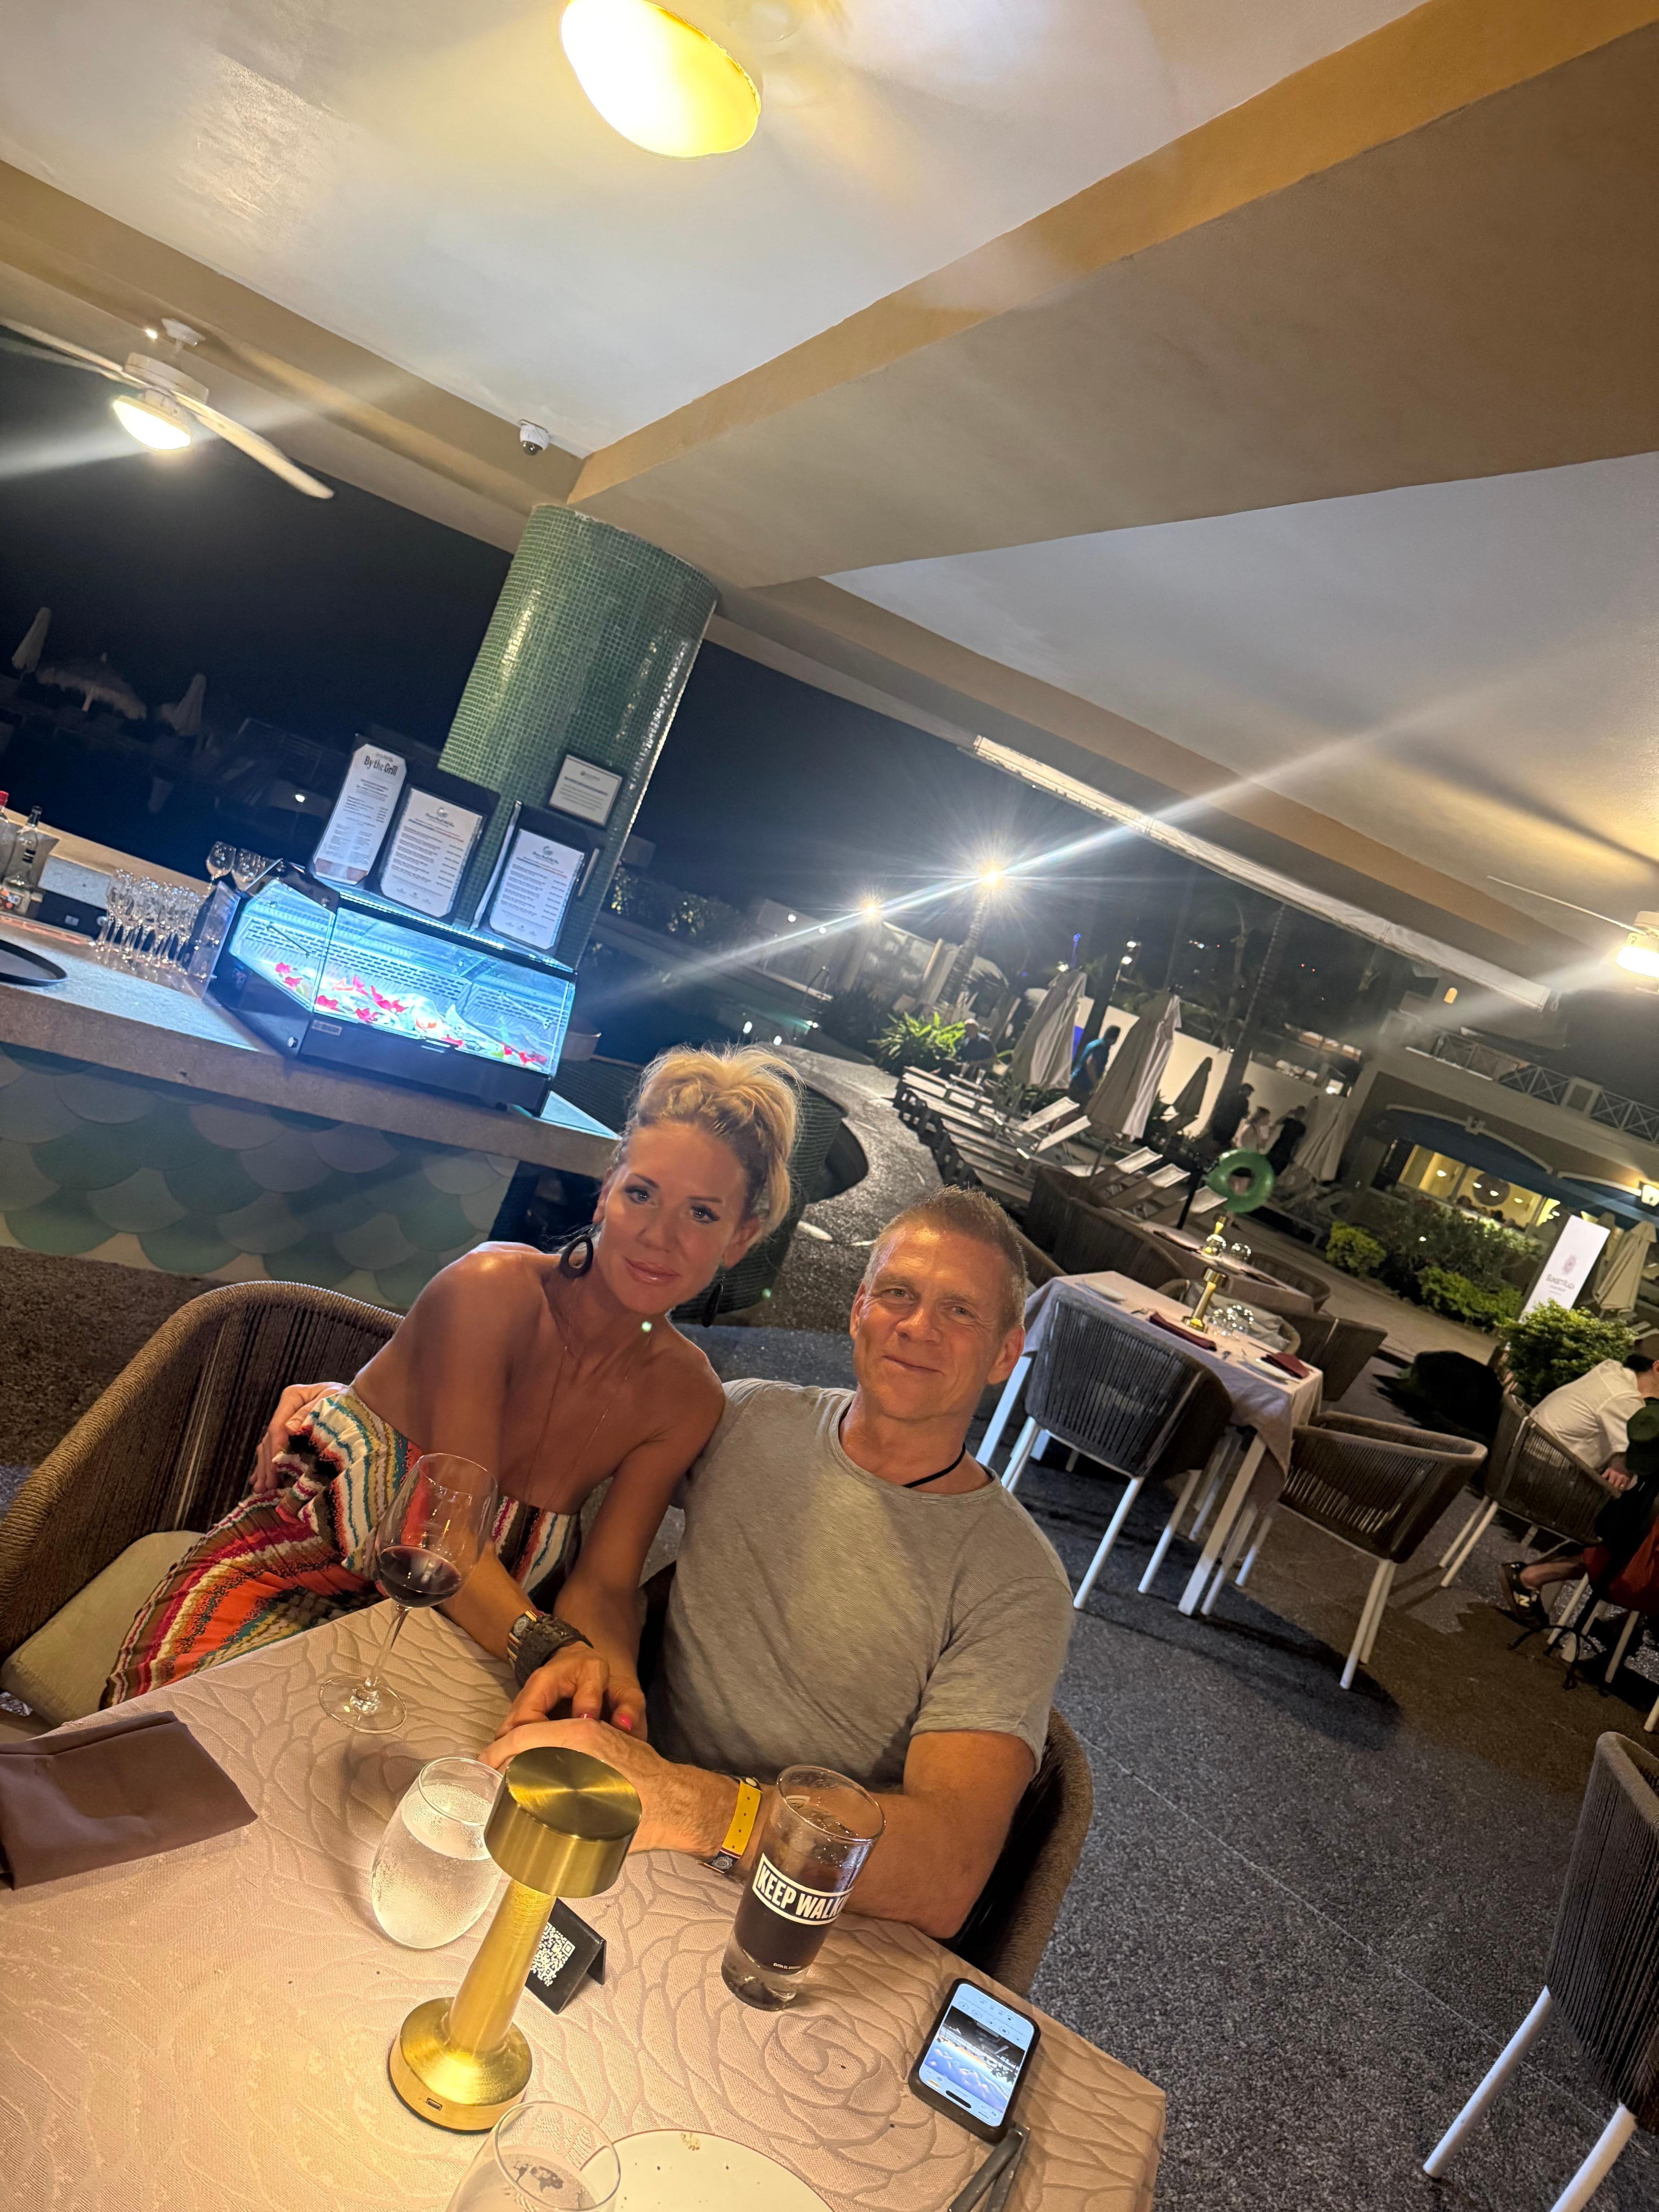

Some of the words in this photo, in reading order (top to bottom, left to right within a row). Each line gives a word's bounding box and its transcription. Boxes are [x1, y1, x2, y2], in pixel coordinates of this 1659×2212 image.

[364, 756, 374, 769] By
[373, 759, 384, 771] the
[384, 763, 398, 776] Grill
[757, 1865, 797, 1909] KEEP
[795, 1891, 851, 1919] WALKI
